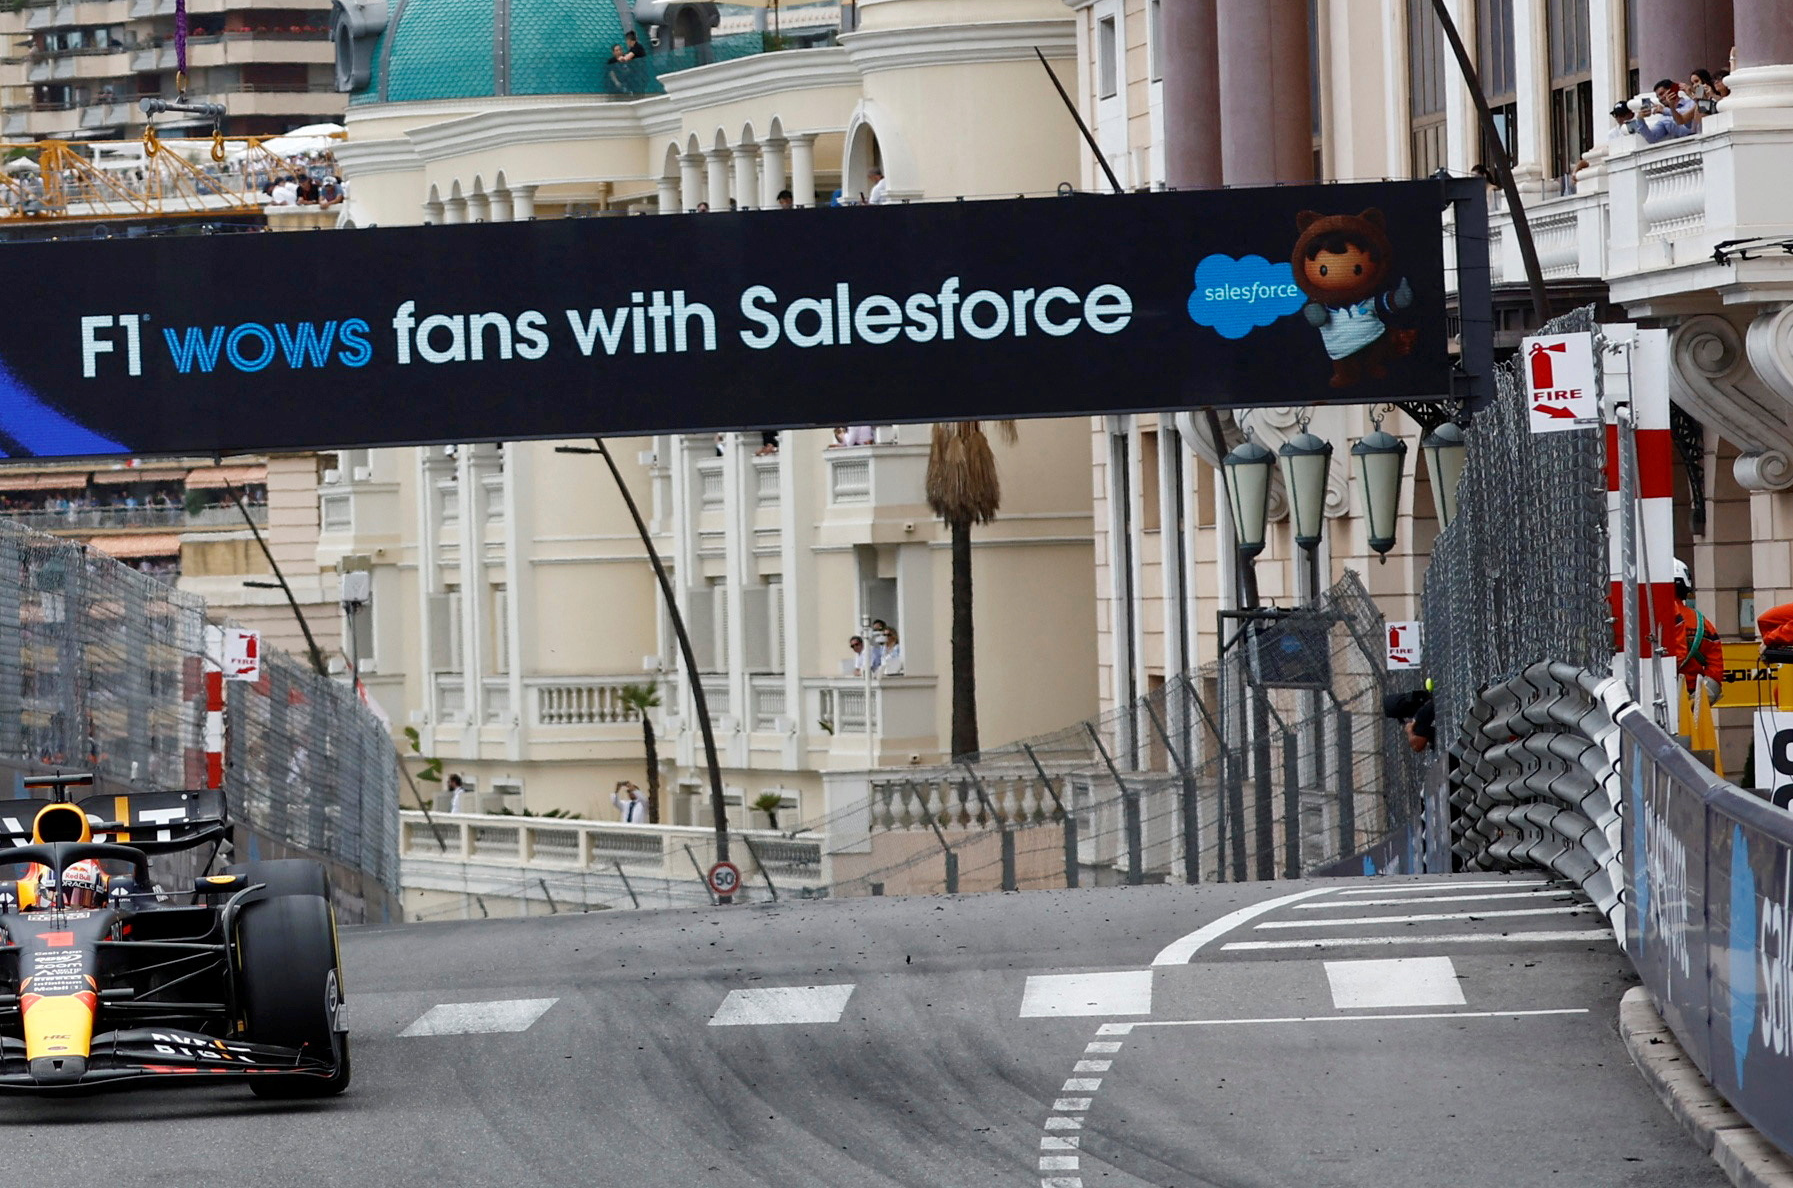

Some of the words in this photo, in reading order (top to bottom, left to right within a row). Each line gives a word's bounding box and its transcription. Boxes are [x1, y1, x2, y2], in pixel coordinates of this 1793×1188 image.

[1205, 281, 1298, 303] salesforce
[393, 300, 549, 364] fans
[565, 289, 717, 356] with
[739, 276, 1133, 350] Salesforce
[1534, 389, 1583, 402] FIRE
[79, 873, 91, 881] Bull
[715, 872, 735, 886] 50
[34, 931, 74, 946] 1
